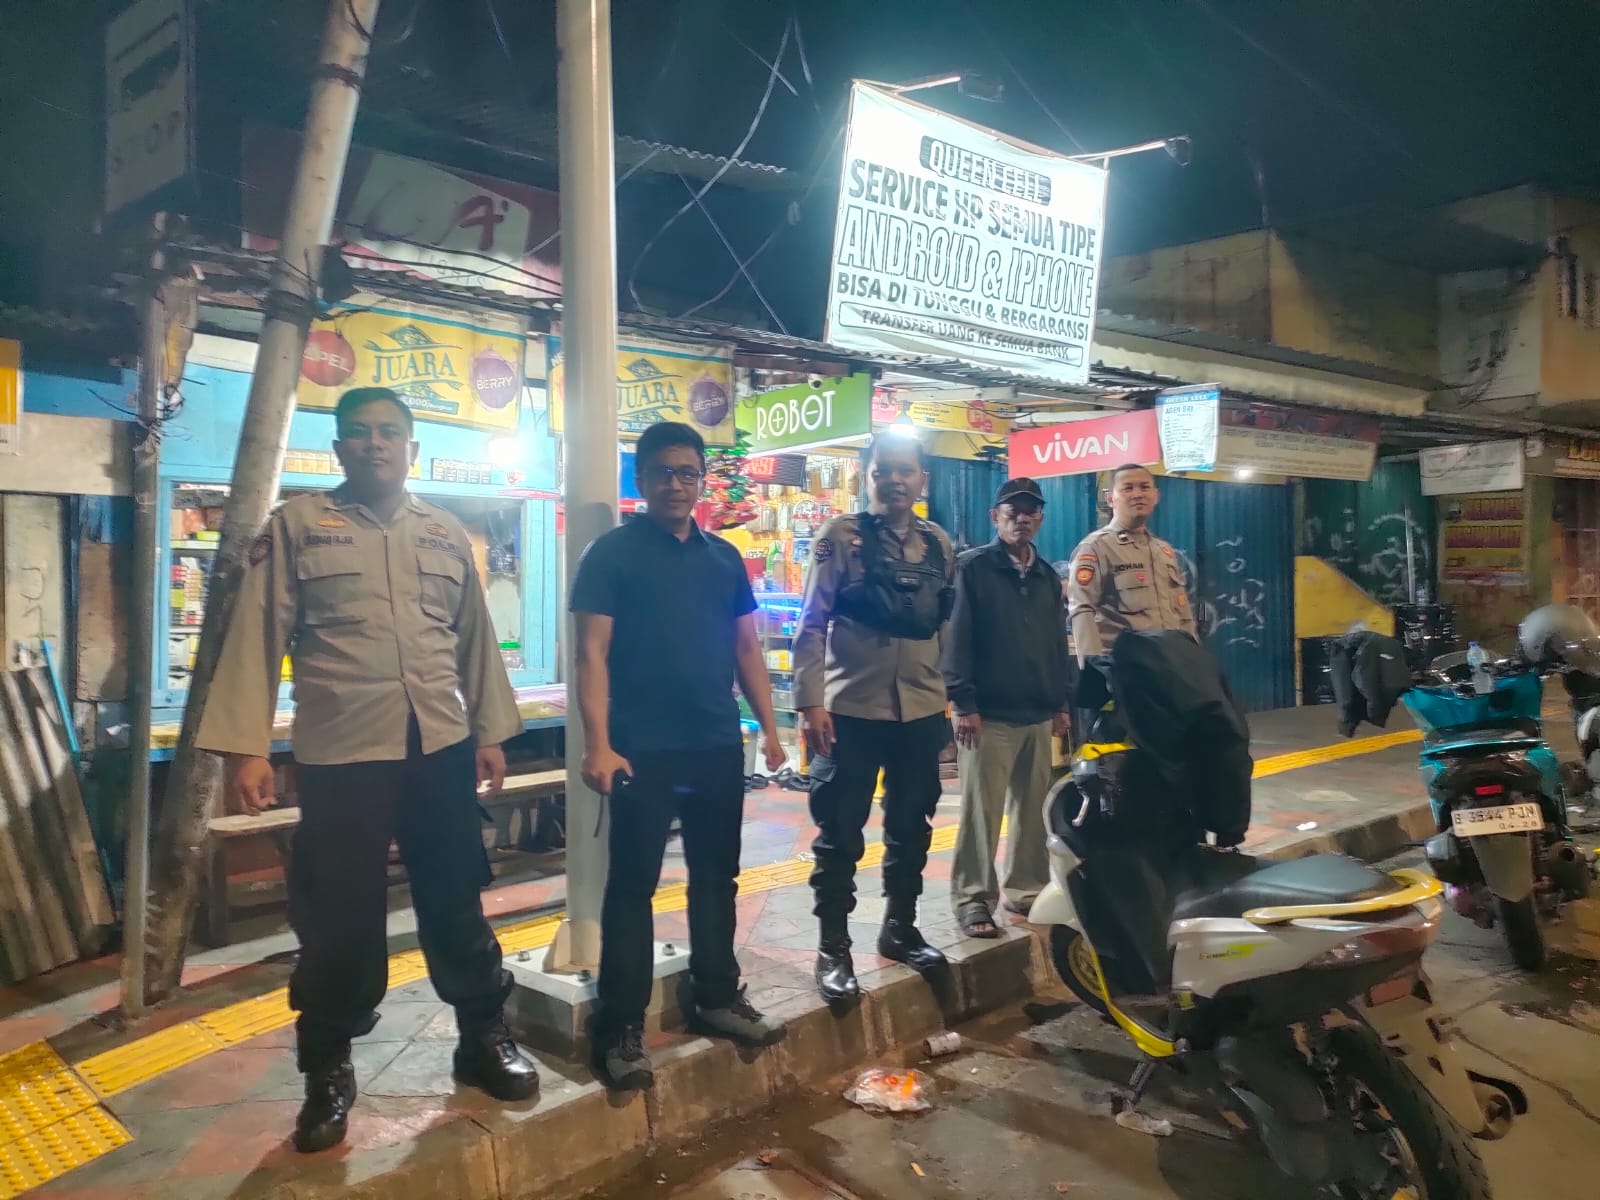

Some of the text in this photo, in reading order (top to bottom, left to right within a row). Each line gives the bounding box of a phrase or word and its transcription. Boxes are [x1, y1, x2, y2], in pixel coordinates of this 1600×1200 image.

[848, 158, 1096, 261] SERVICE HP SEMUA TIPE
[838, 205, 1094, 319] ANDROID & IPHONE
[836, 272, 1089, 341] BISA DI TUNGGU & BERGARANSI
[861, 309, 935, 335] TRANSFER
[938, 322, 975, 342] UANG
[977, 330, 993, 345] KE
[1037, 342, 1070, 360] BANK
[372, 352, 457, 383] JUARA
[476, 375, 512, 391] BERRY
[616, 381, 680, 409] JUARA
[757, 391, 836, 440] ROBOT
[1454, 813, 1462, 824] B
[1507, 805, 1534, 818] PJN
